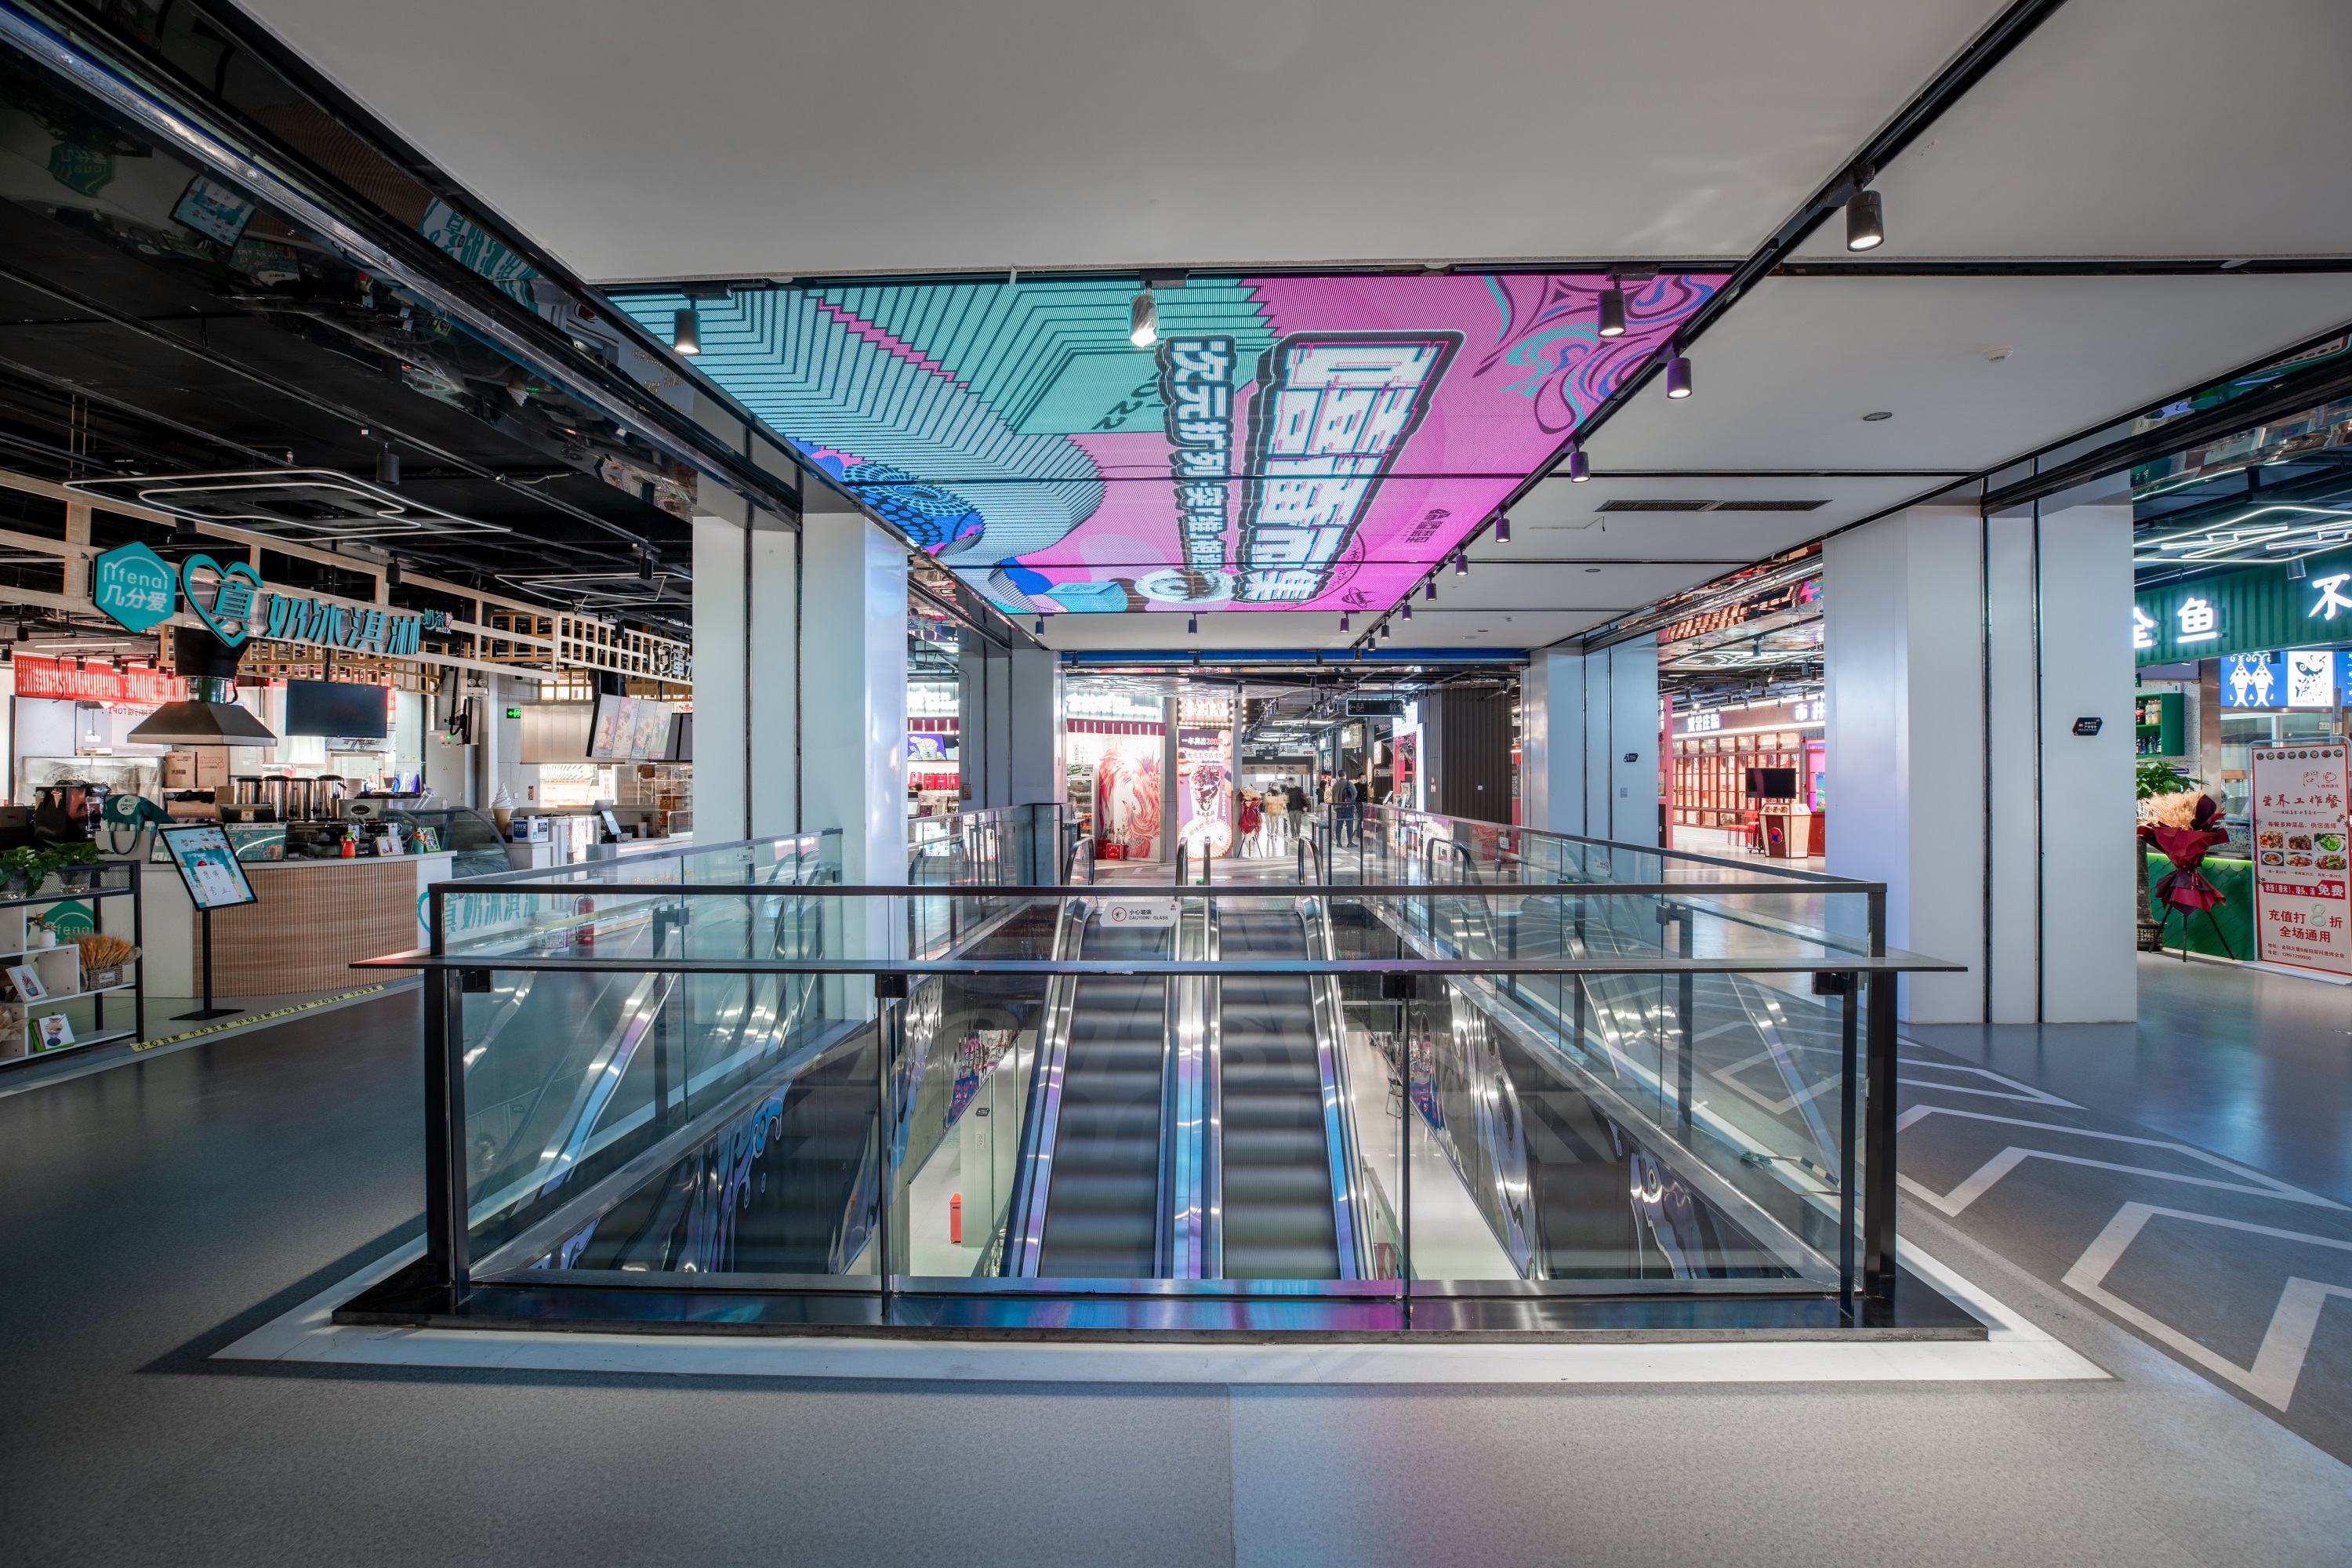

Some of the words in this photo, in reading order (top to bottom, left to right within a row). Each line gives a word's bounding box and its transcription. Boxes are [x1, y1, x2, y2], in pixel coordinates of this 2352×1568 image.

[1243, 344, 1440, 601] 嘻番市集
[102, 584, 167, 612] 几分爱
[210, 579, 421, 655] 真奶冰淇淋
[421, 608, 445, 630] 奶茶
[2263, 793, 2342, 808] 营养工作餐
[2318, 883, 2343, 897] 免费
[2279, 926, 2331, 943] 全场通用
